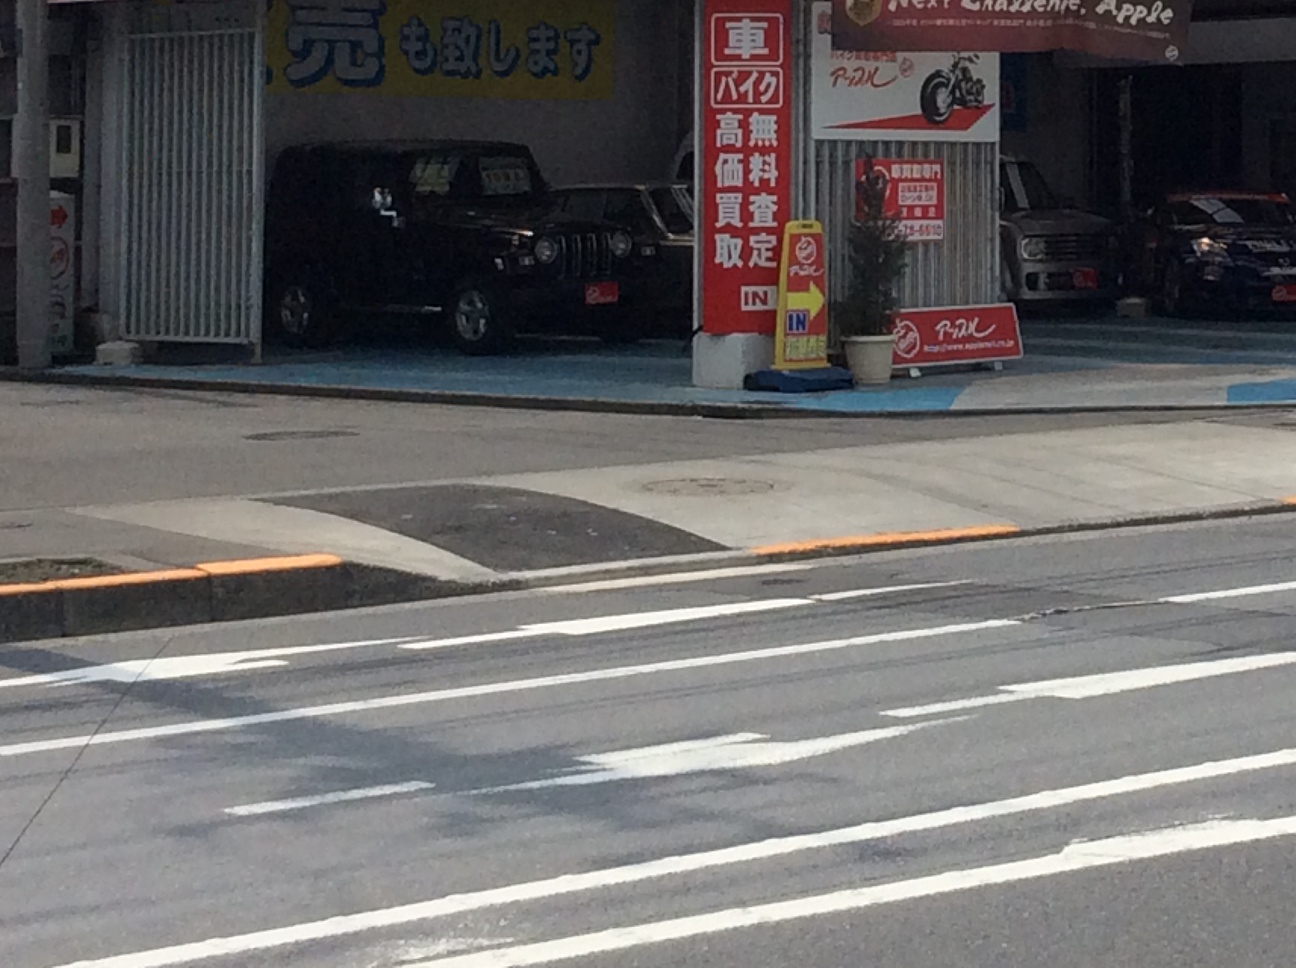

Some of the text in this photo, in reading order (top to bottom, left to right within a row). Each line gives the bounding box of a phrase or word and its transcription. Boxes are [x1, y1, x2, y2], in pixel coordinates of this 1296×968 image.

[724, 18, 769, 59] 車
[716, 70, 778, 104] バイク
[830, 66, 898, 88] アップル
[714, 112, 744, 269] 高価買取
[748, 112, 778, 269] 無料査定
[743, 289, 769, 307] IN
[788, 312, 806, 332] IN
[935, 317, 997, 341] アップル
